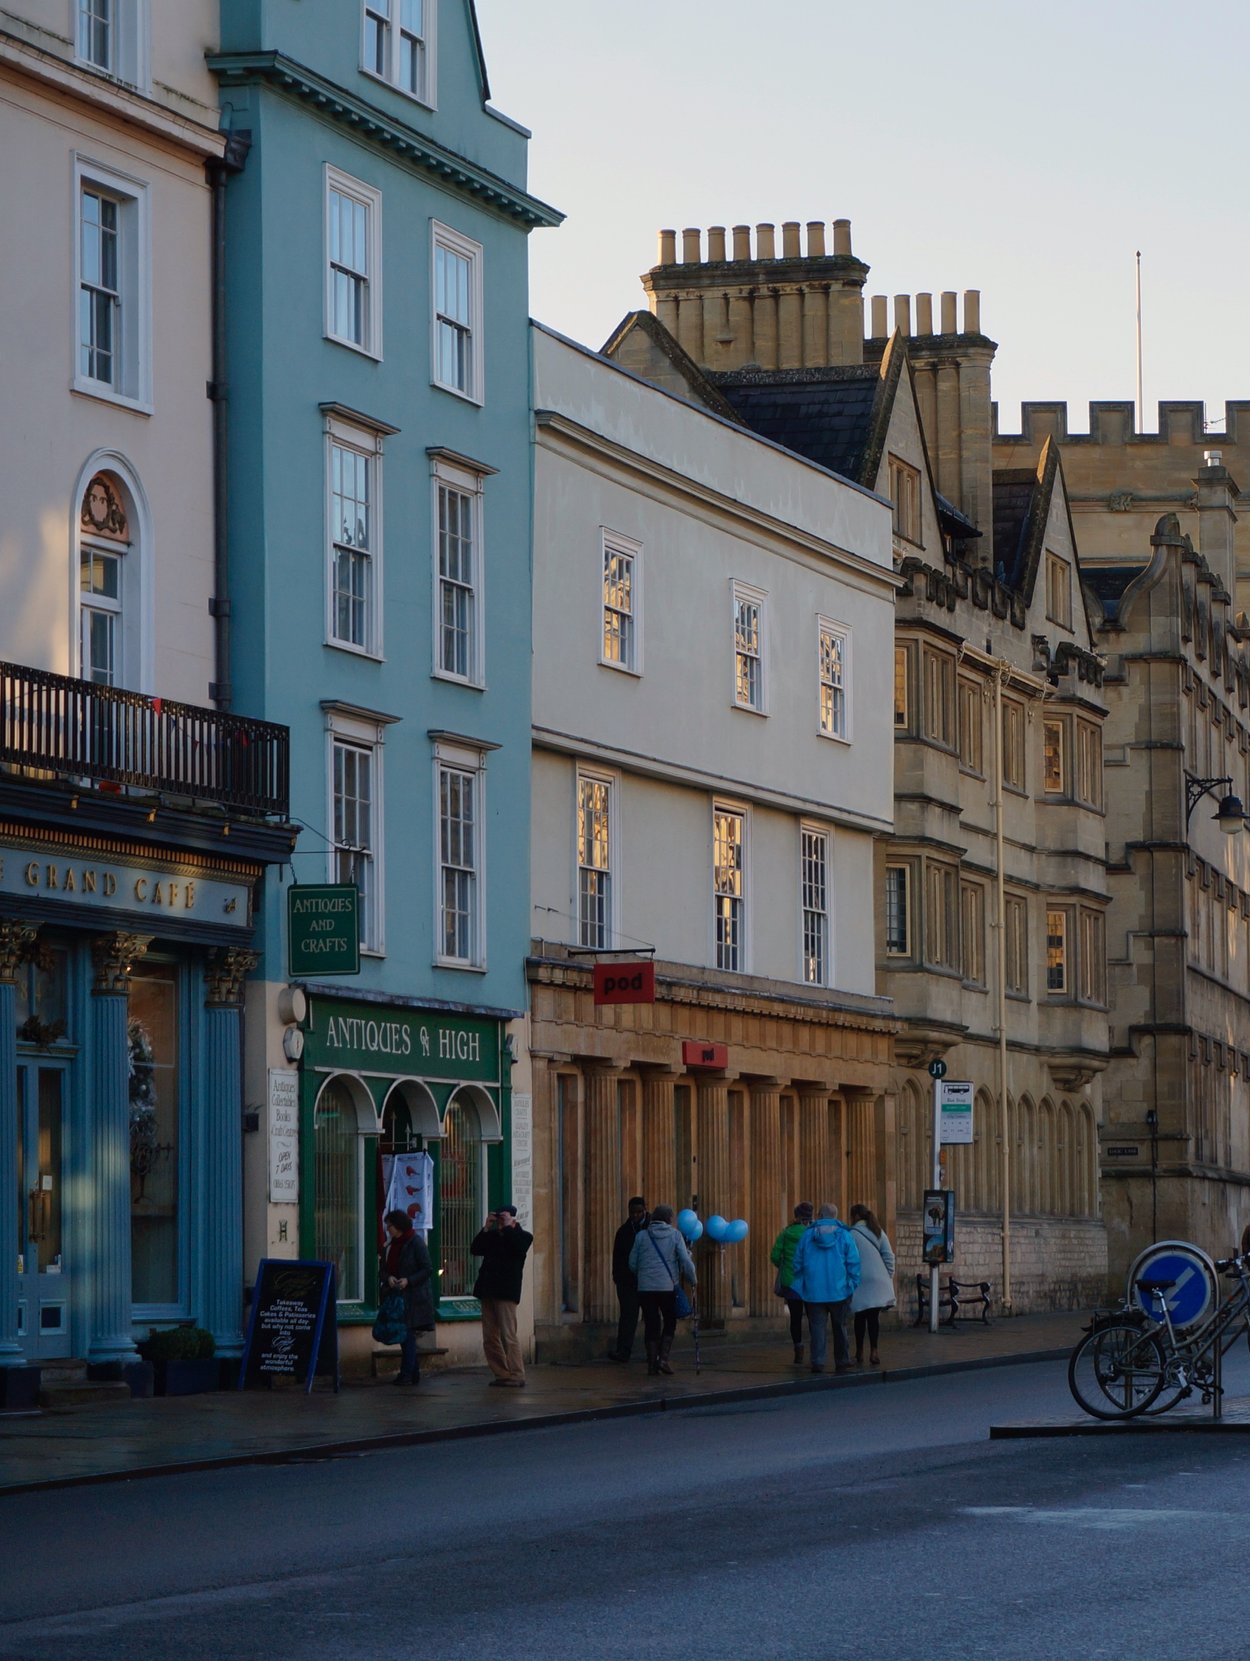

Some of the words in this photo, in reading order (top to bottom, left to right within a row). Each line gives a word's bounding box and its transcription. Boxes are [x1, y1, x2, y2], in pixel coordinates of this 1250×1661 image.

[26, 861, 117, 896] GRAND
[135, 878, 195, 909] CAFÉ
[293, 898, 352, 913] ANTIQUES
[309, 919, 335, 931] AND
[301, 937, 347, 953] CRAFTS
[604, 973, 642, 995] pod
[326, 1016, 411, 1055] ANTIQUES
[439, 1029, 480, 1061] HIGH
[702, 1048, 714, 1062] pod
[932, 1063, 943, 1074] J1
[277, 1299, 304, 1307] Takeaway
